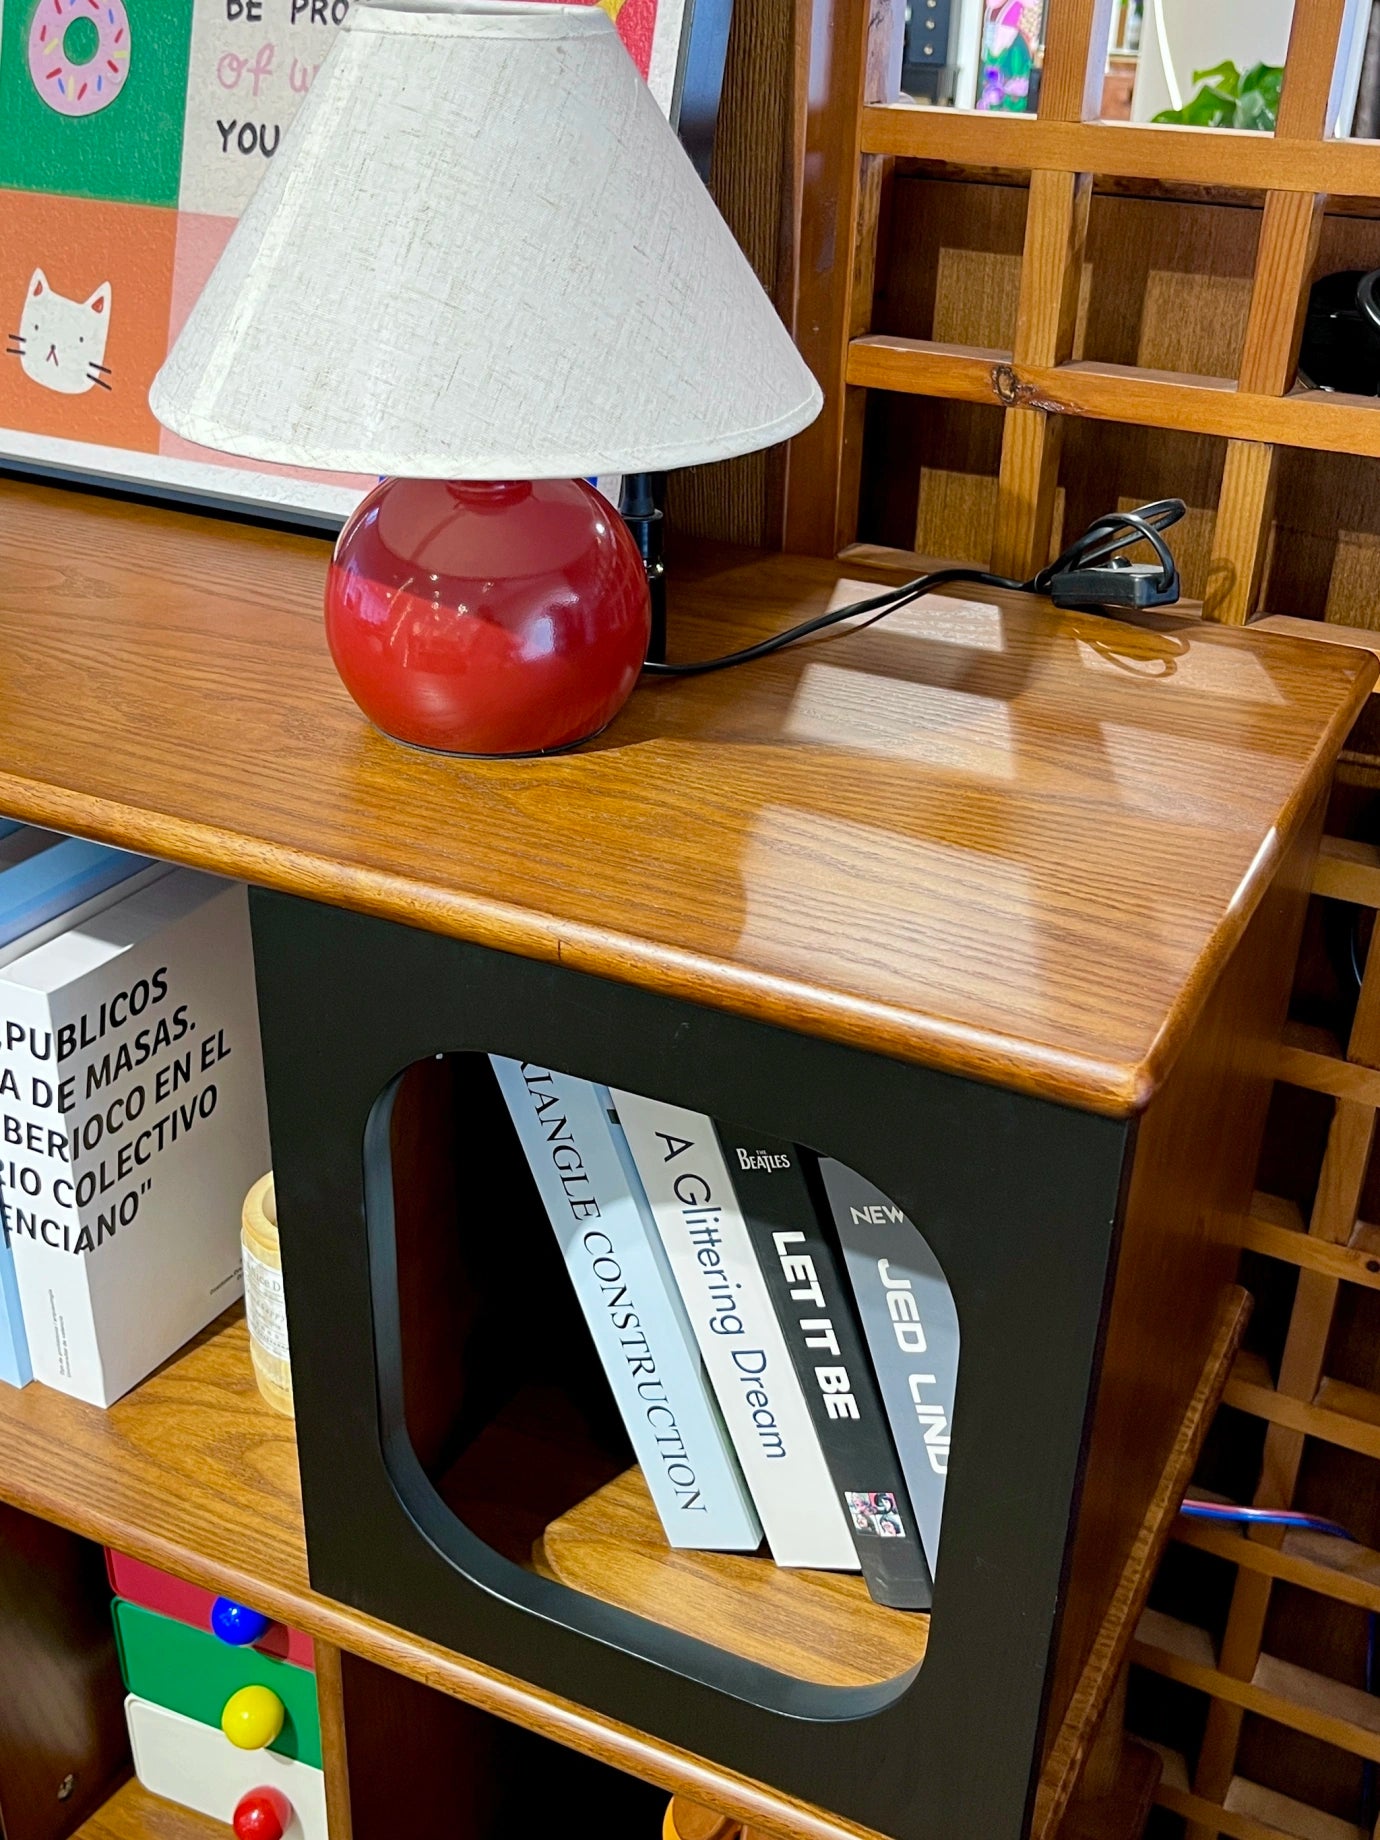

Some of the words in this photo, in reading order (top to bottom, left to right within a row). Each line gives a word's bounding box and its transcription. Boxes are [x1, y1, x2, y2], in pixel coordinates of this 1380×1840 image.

[227, 0, 262, 21] BE
[216, 119, 280, 158] YOU
[0, 967, 168, 1063] PUBLICOS
[32, 1076, 76, 1114] DE
[86, 1005, 196, 1099] MASAS.
[155, 1051, 192, 1104] EN
[201, 1029, 231, 1073] EL
[53, 1084, 217, 1208] COLECTIVO
[655, 1131, 695, 1163] A
[850, 1206, 904, 1225] NEW
[520, 1061, 602, 1221] IANGLE
[583, 1230, 708, 1513] CONSTRUCTION
[674, 1173, 746, 1336] Glittering
[772, 1231, 826, 1308] LET
[800, 1319, 841, 1356] IT
[878, 1258, 927, 1353] JED
[731, 1350, 787, 1459] Dream
[814, 1366, 861, 1419] BE
